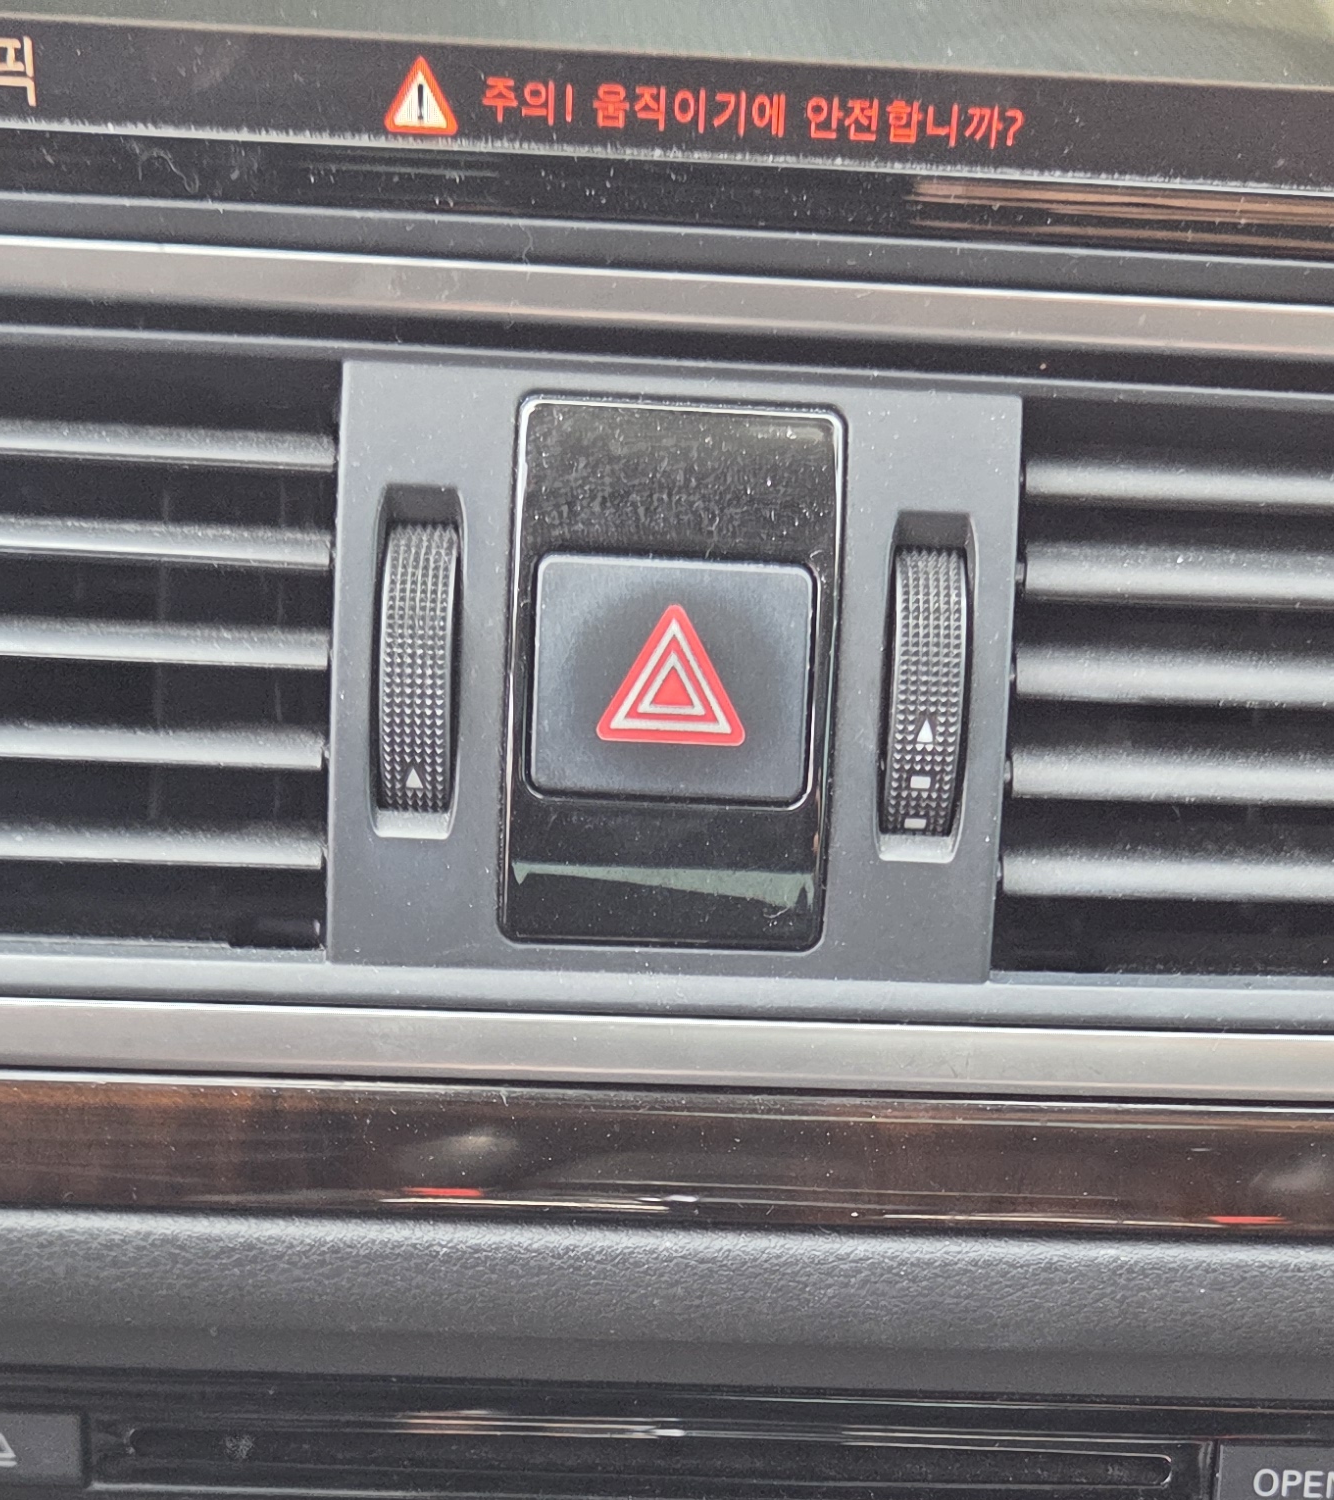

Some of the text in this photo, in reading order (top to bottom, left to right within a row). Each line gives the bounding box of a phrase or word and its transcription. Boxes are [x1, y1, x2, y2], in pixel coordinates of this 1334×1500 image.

[481, 76, 1025, 149] 주의! 움직이기에 안전합니까?
